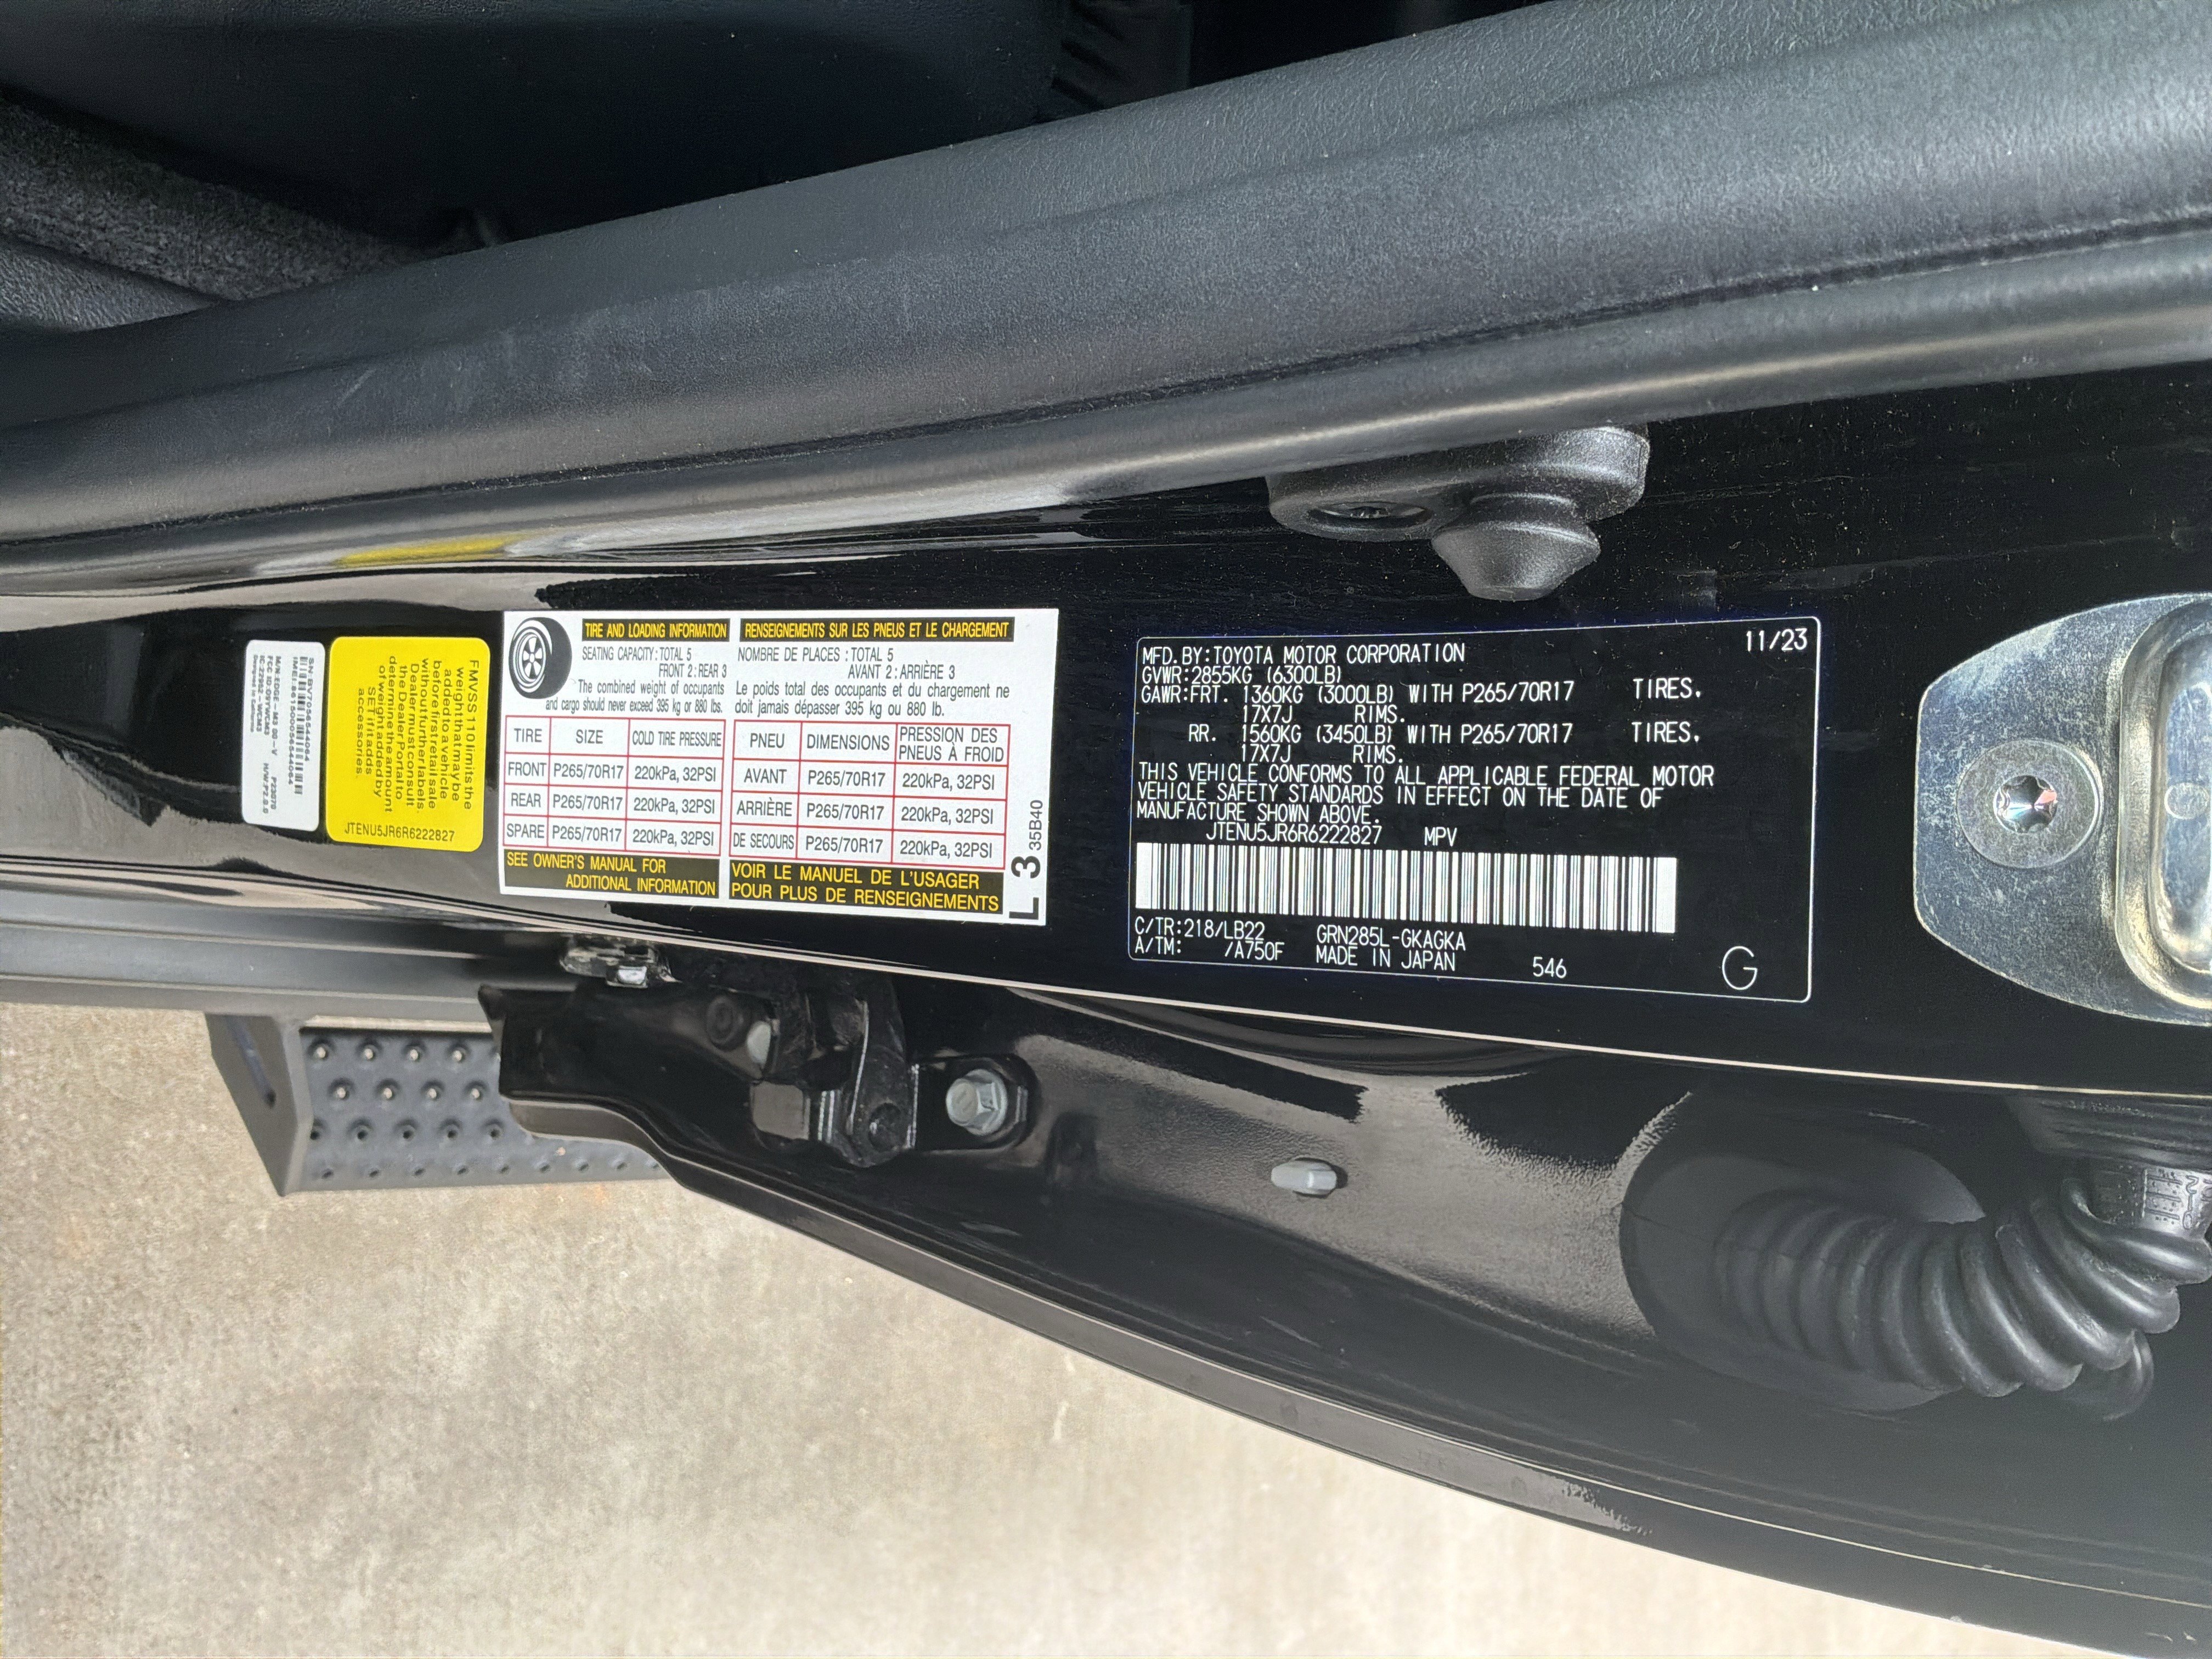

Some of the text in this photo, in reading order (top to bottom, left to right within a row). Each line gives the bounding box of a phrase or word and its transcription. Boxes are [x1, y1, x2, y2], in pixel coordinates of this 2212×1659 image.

[585, 623, 727, 639] TIRE AND LOADING INFORMATION
[745, 622, 1009, 639] RENSEIGNEMENTS SUR LES PNEUS ET LE CHARGEMENT
[1746, 628, 1808, 652] 11/23
[582, 646, 614, 661] SEATING
[737, 646, 840, 662] NOMBRE DE PLACES
[1142, 642, 1465, 665] MFD.BY:TOYOTA MOTOR CORPORATION
[419, 658, 430, 713] without
[1142, 664, 1341, 685] GVWR:2855KG (6300LB)
[578, 679, 725, 698] The combined weight of occupants
[1141, 677, 1701, 704] GAWR:FRT. 1360KG (3000LB) WITH P265/70R17 TIRES.
[545, 697, 723, 716] and cargo should never exceed 395 kg or 880 lbs.
[1243, 704, 1405, 724] 17X7J RIMS.
[384, 656, 398, 812] determine the amount
[396, 665, 408, 800] the Dealer Portal to
[406, 663, 420, 807] Dealer must consult
[417, 715, 428, 764] further
[428, 660, 442, 809] before first retail sale
[449, 667, 465, 802] weight that may be
[464, 660, 479, 810] FMVSS 110 limits the
[514, 727, 543, 743] TIRE
[575, 729, 603, 744] SIZE
[632, 730, 722, 747] COLD TIRE PRESSURE
[750, 732, 785, 749] PNEU
[806, 733, 890, 751] DIMENSIONS
[900, 726, 997, 743] PRESSION DES
[1188, 721, 1700, 744] RR. 1560KG (3450LB) WITH P265/70R17 TIRES.
[899, 744, 1004, 763] PNEUS FROID
[508, 761, 548, 777] FRONT
[554, 763, 624, 780] P265/70R17
[634, 765, 716, 783] 220kPa, 32PSI
[743, 768, 787, 784] AVANT
[808, 770, 886, 787] P265/70R17
[1139, 761, 1714, 787] THIS VEHICLE CONFORMS TO ALL APPLICABLE FEDERAL MOTOR
[902, 772, 995, 792] 220kPa, 32PSI
[511, 792, 541, 808] REAR
[1138, 781, 1664, 809] VEHICLE SAFETY STANDARDS IN EFFECT ON THE DATE OF
[736, 797, 793, 817] ARRIÈRE
[1137, 800, 1379, 825] MANUFACTURE SHOWN ABOVE.
[344, 821, 455, 842] JTENU5JR6R6222827
[506, 823, 545, 839] SPARE
[1028, 799, 1043, 851] 35B40
[1206, 821, 1457, 847] JTENU5JR6R6222827 MPV
[507, 851, 666, 874] SEE OWNER'S MANUAL FOR
[1011, 855, 1041, 879] 3
[566, 873, 715, 896] ADDITIONAL INFORMATION
[731, 862, 979, 890] VOIR LE MANUEL DE L'USAGER
[732, 882, 999, 912] POUR PLUS DE RENSEIGNEMENTS
[1135, 935, 1181, 955] A/TM:
[1317, 924, 1466, 951] GRN285L-GKAGKA
[1316, 944, 1455, 972] MADE IN JAPAN
[1532, 956, 1567, 979] 546
[1722, 946, 1758, 990] G
